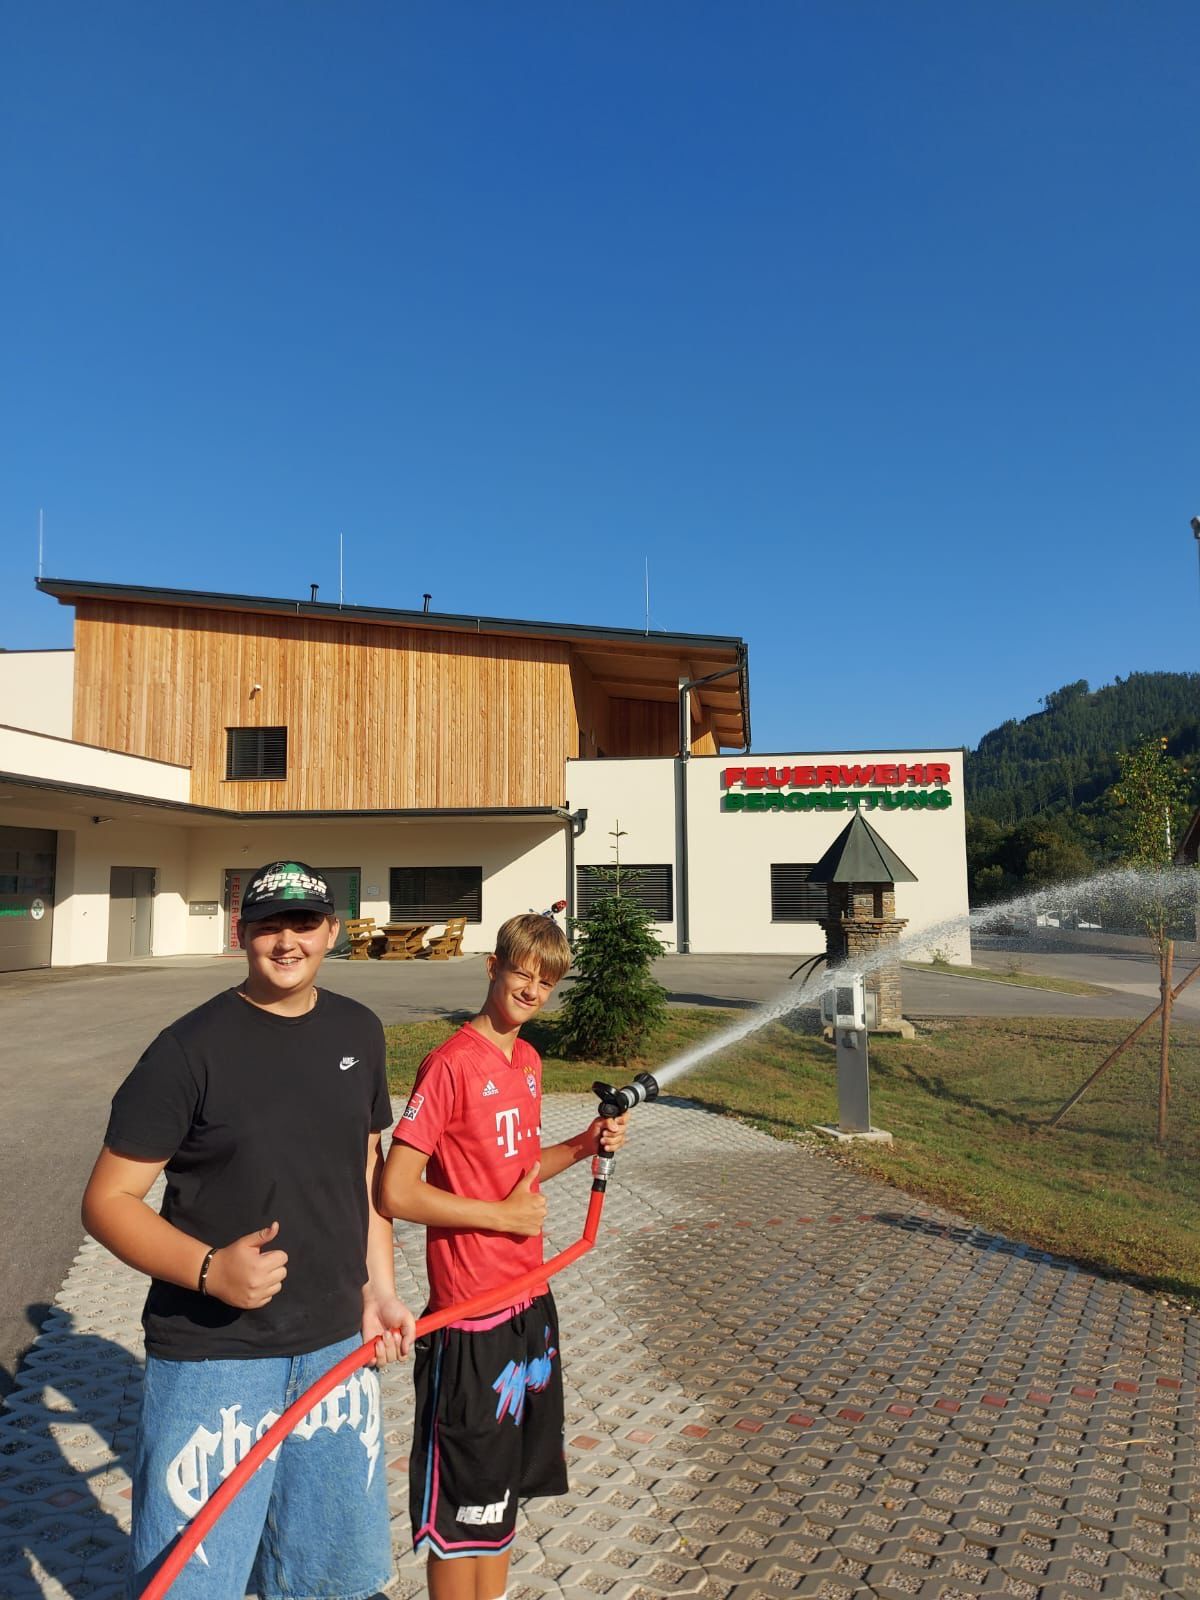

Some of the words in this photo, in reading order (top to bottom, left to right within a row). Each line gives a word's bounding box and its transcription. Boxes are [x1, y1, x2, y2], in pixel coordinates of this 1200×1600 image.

[722, 763, 952, 788] FEUERWEHR
[722, 789, 953, 811] BERGRETTUNG
[230, 876, 241, 948] FEUERWEHR
[456, 1488, 511, 1526] HEAT
